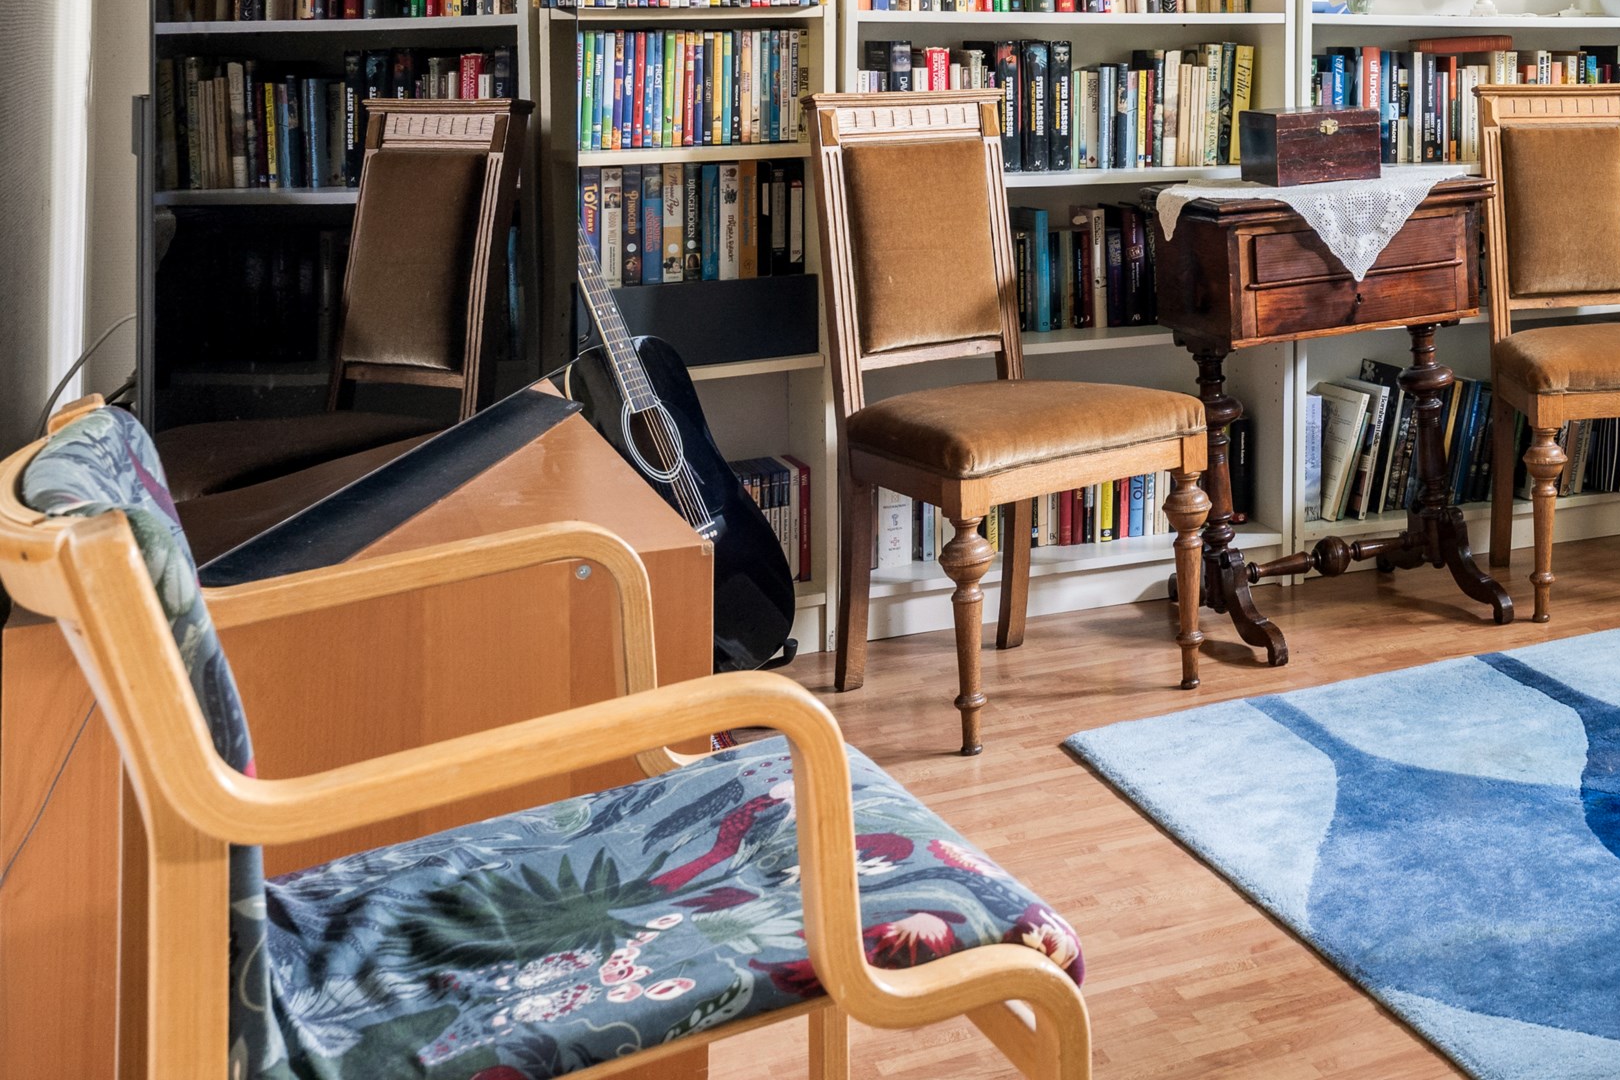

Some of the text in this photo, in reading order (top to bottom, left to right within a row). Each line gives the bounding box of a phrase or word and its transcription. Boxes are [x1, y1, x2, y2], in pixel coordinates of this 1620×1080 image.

[800, 67, 808, 91] BORAT
[1236, 64, 1251, 100] Frihet
[1335, 69, 1343, 93] Lundell
[1369, 61, 1378, 107] ulf lundell
[1006, 101, 1014, 137] LARSSON
[1036, 100, 1044, 136] LARSSON
[1060, 76, 1068, 136] STIEG LARSSON
[584, 184, 598, 210] TOY
[623, 190, 639, 234] PINOCCHIO
[687, 179, 696, 238] DJUNGELBOKEN
[1376, 395, 1387, 429] Bornholm
